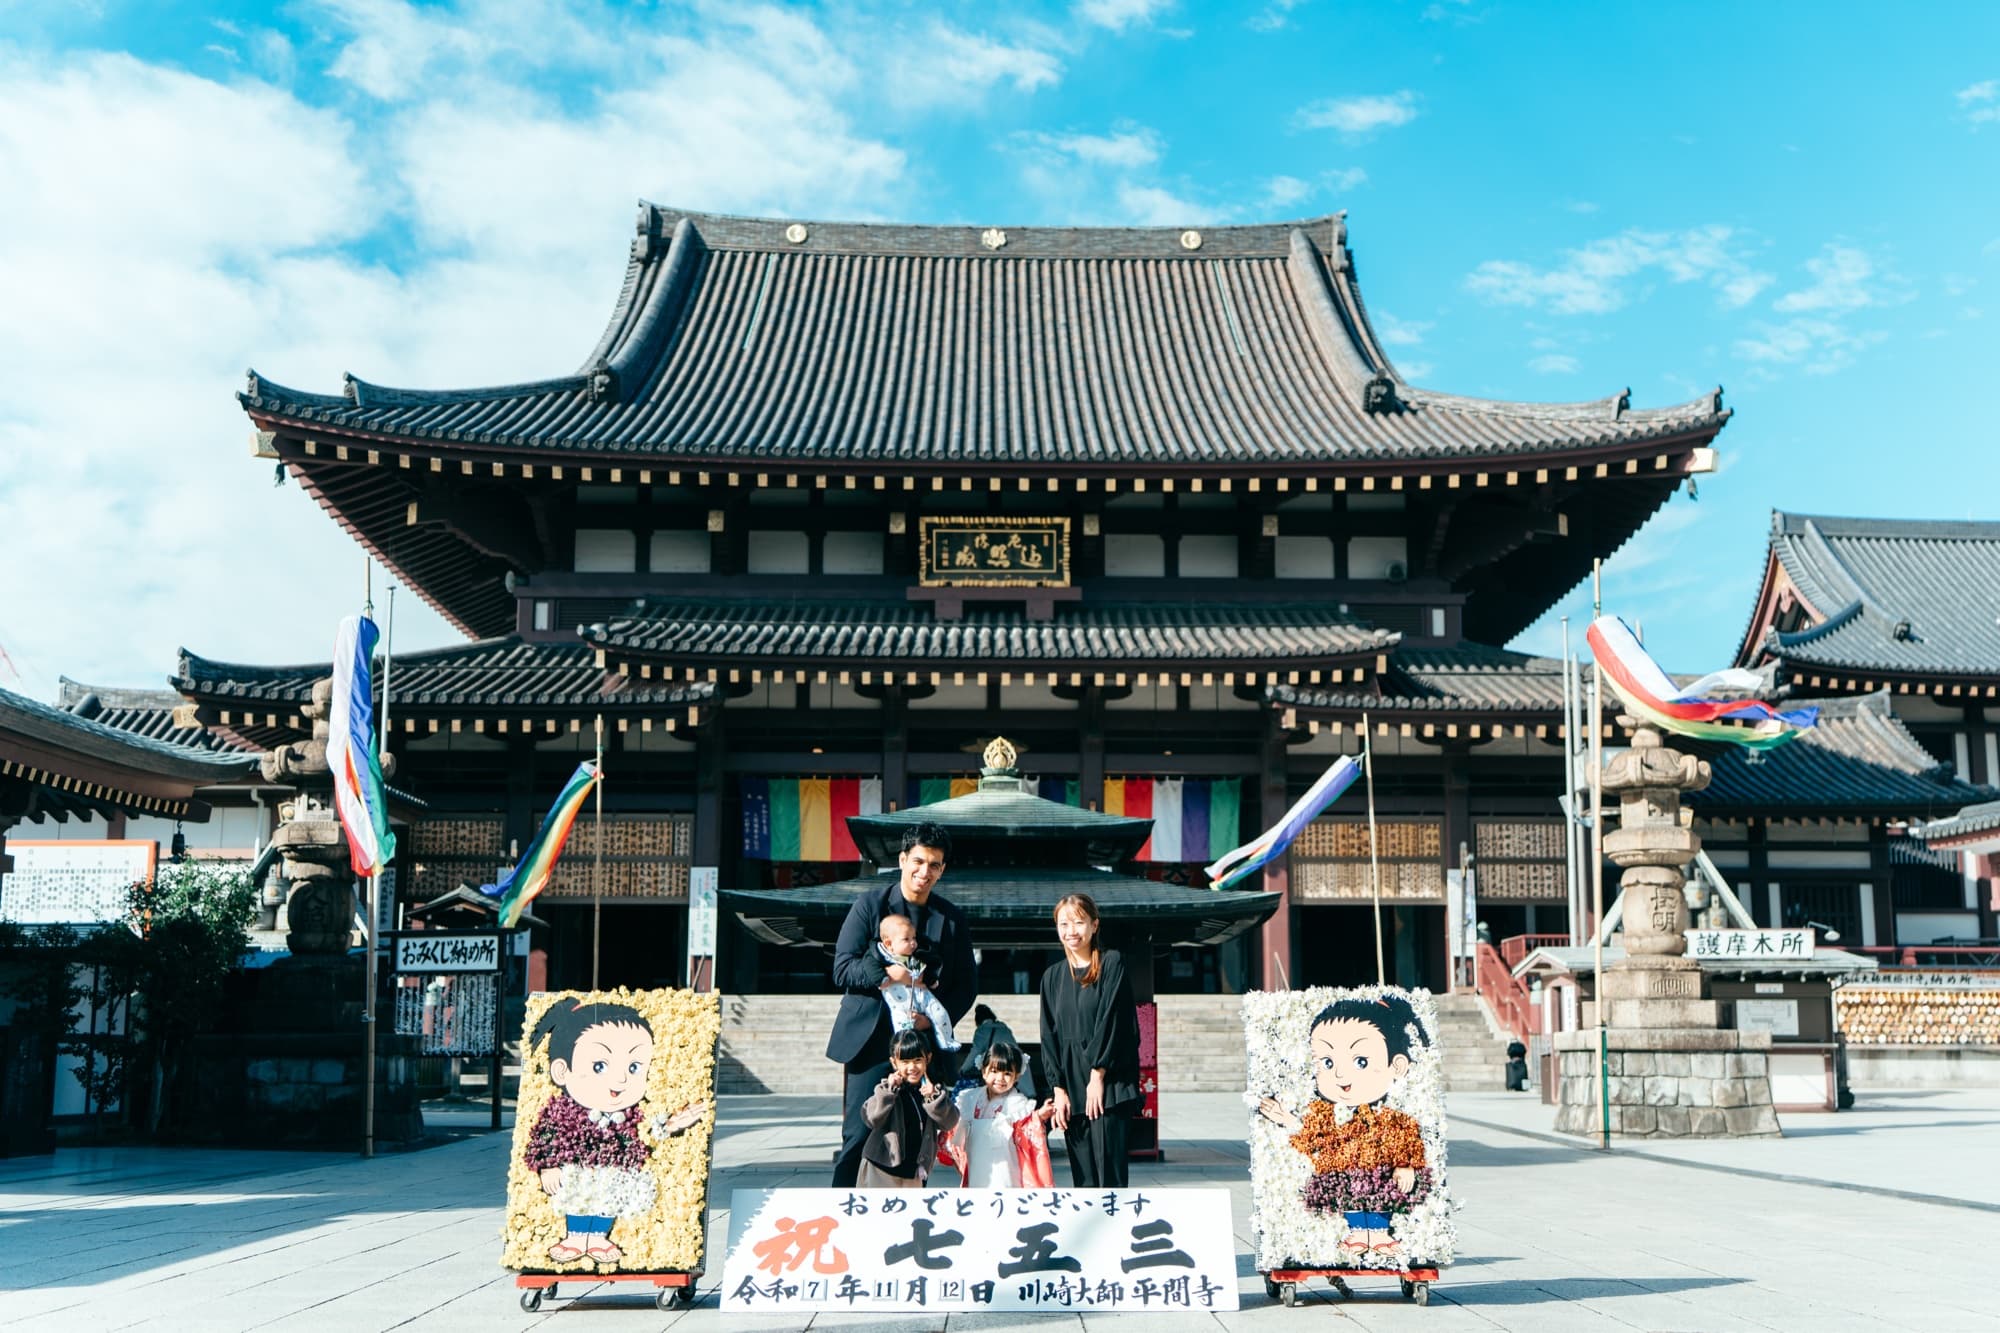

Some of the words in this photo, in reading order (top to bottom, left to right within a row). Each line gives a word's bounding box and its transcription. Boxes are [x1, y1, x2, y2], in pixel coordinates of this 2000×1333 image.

[402, 939, 496, 966] おみくじ納め所
[1696, 932, 1804, 956] 護摩木所
[838, 1191, 1152, 1217] おめでとうございます
[752, 1214, 850, 1275] 祝
[884, 1218, 1196, 1279] 七五三
[1017, 1275, 1124, 1307] 川崎大師
[1131, 1274, 1225, 1307] 平間寺
